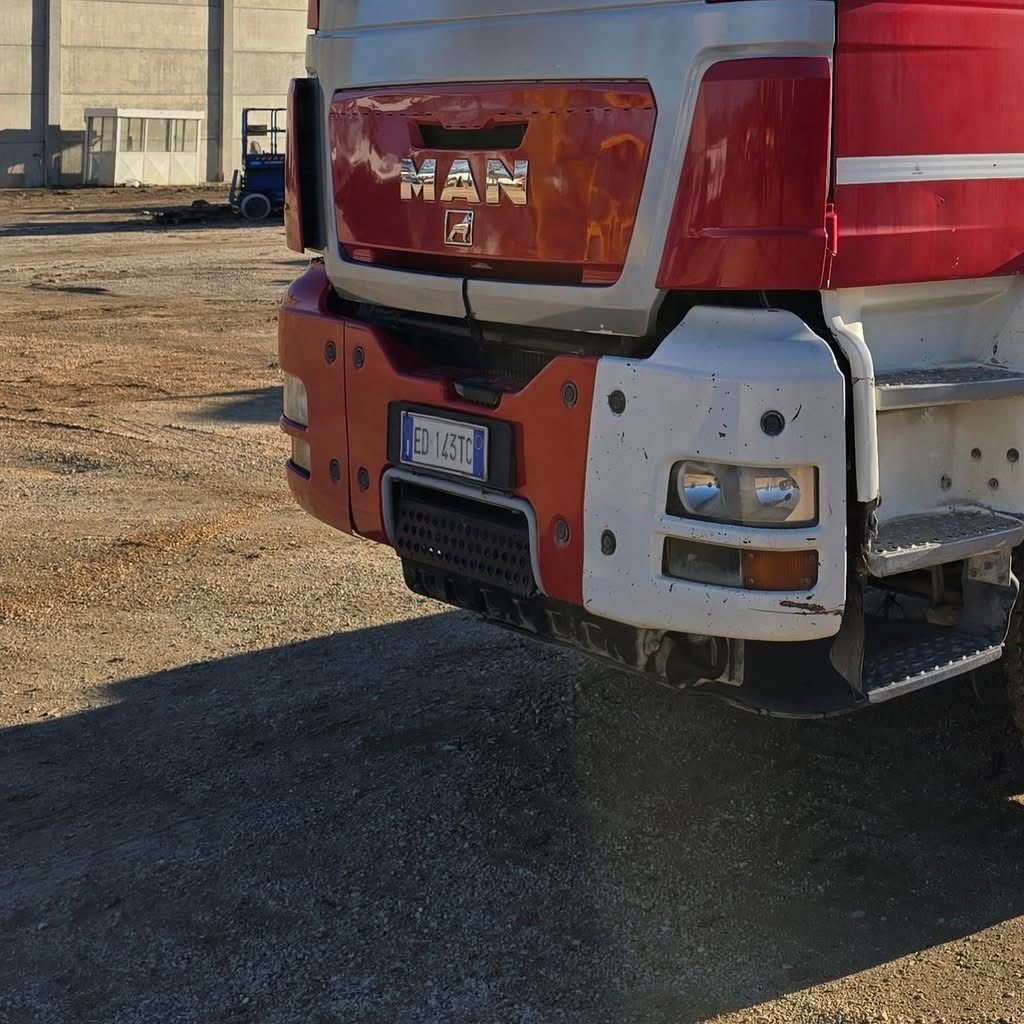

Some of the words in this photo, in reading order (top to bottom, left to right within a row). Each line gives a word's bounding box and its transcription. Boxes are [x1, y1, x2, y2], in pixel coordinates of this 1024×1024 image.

[399, 157, 529, 206] MAN
[414, 427, 429, 456] ED
[436, 431, 473, 465] 143TC
